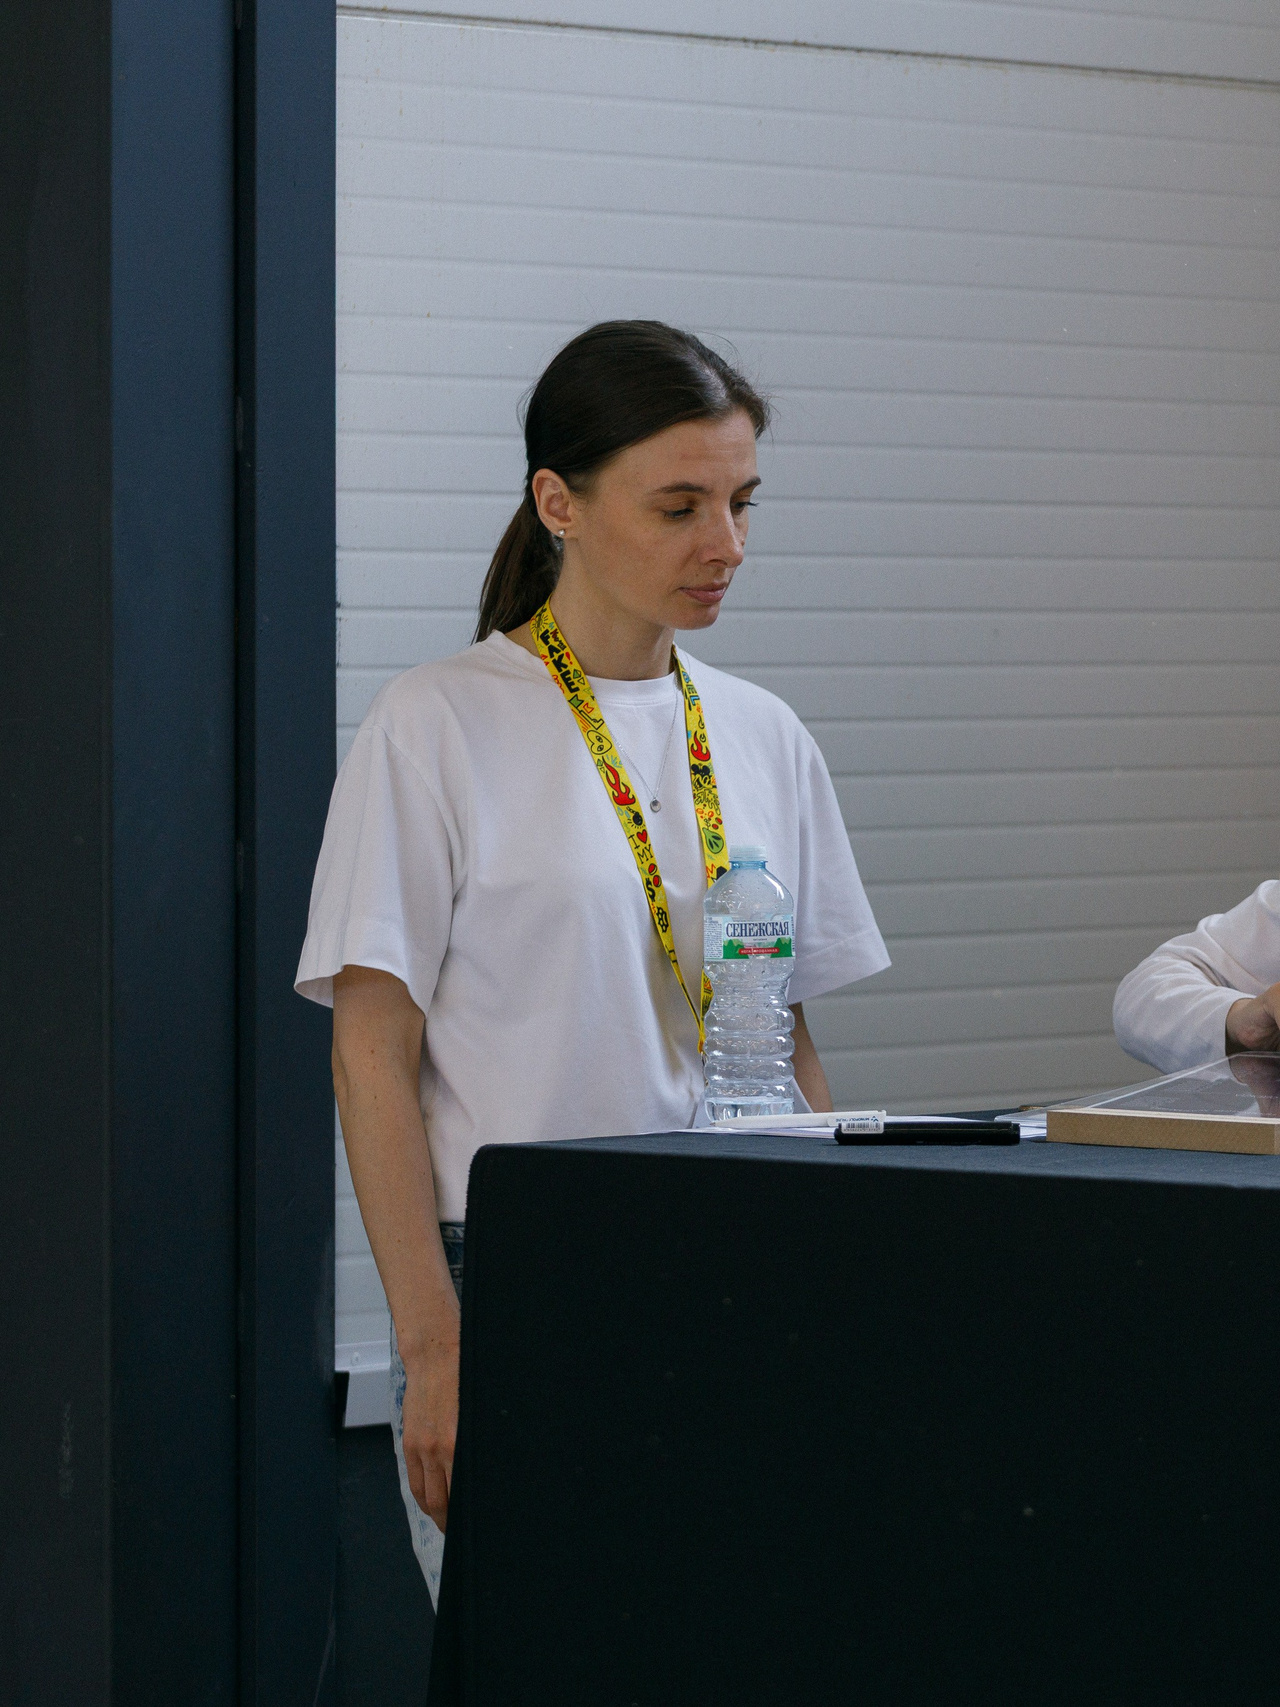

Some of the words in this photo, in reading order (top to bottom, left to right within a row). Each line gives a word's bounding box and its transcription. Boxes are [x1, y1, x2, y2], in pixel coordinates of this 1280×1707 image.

[540, 629, 580, 693] FAKE
[637, 844, 653, 864] MY
[726, 922, 789, 937] СЕНЕЖСКАЯ
